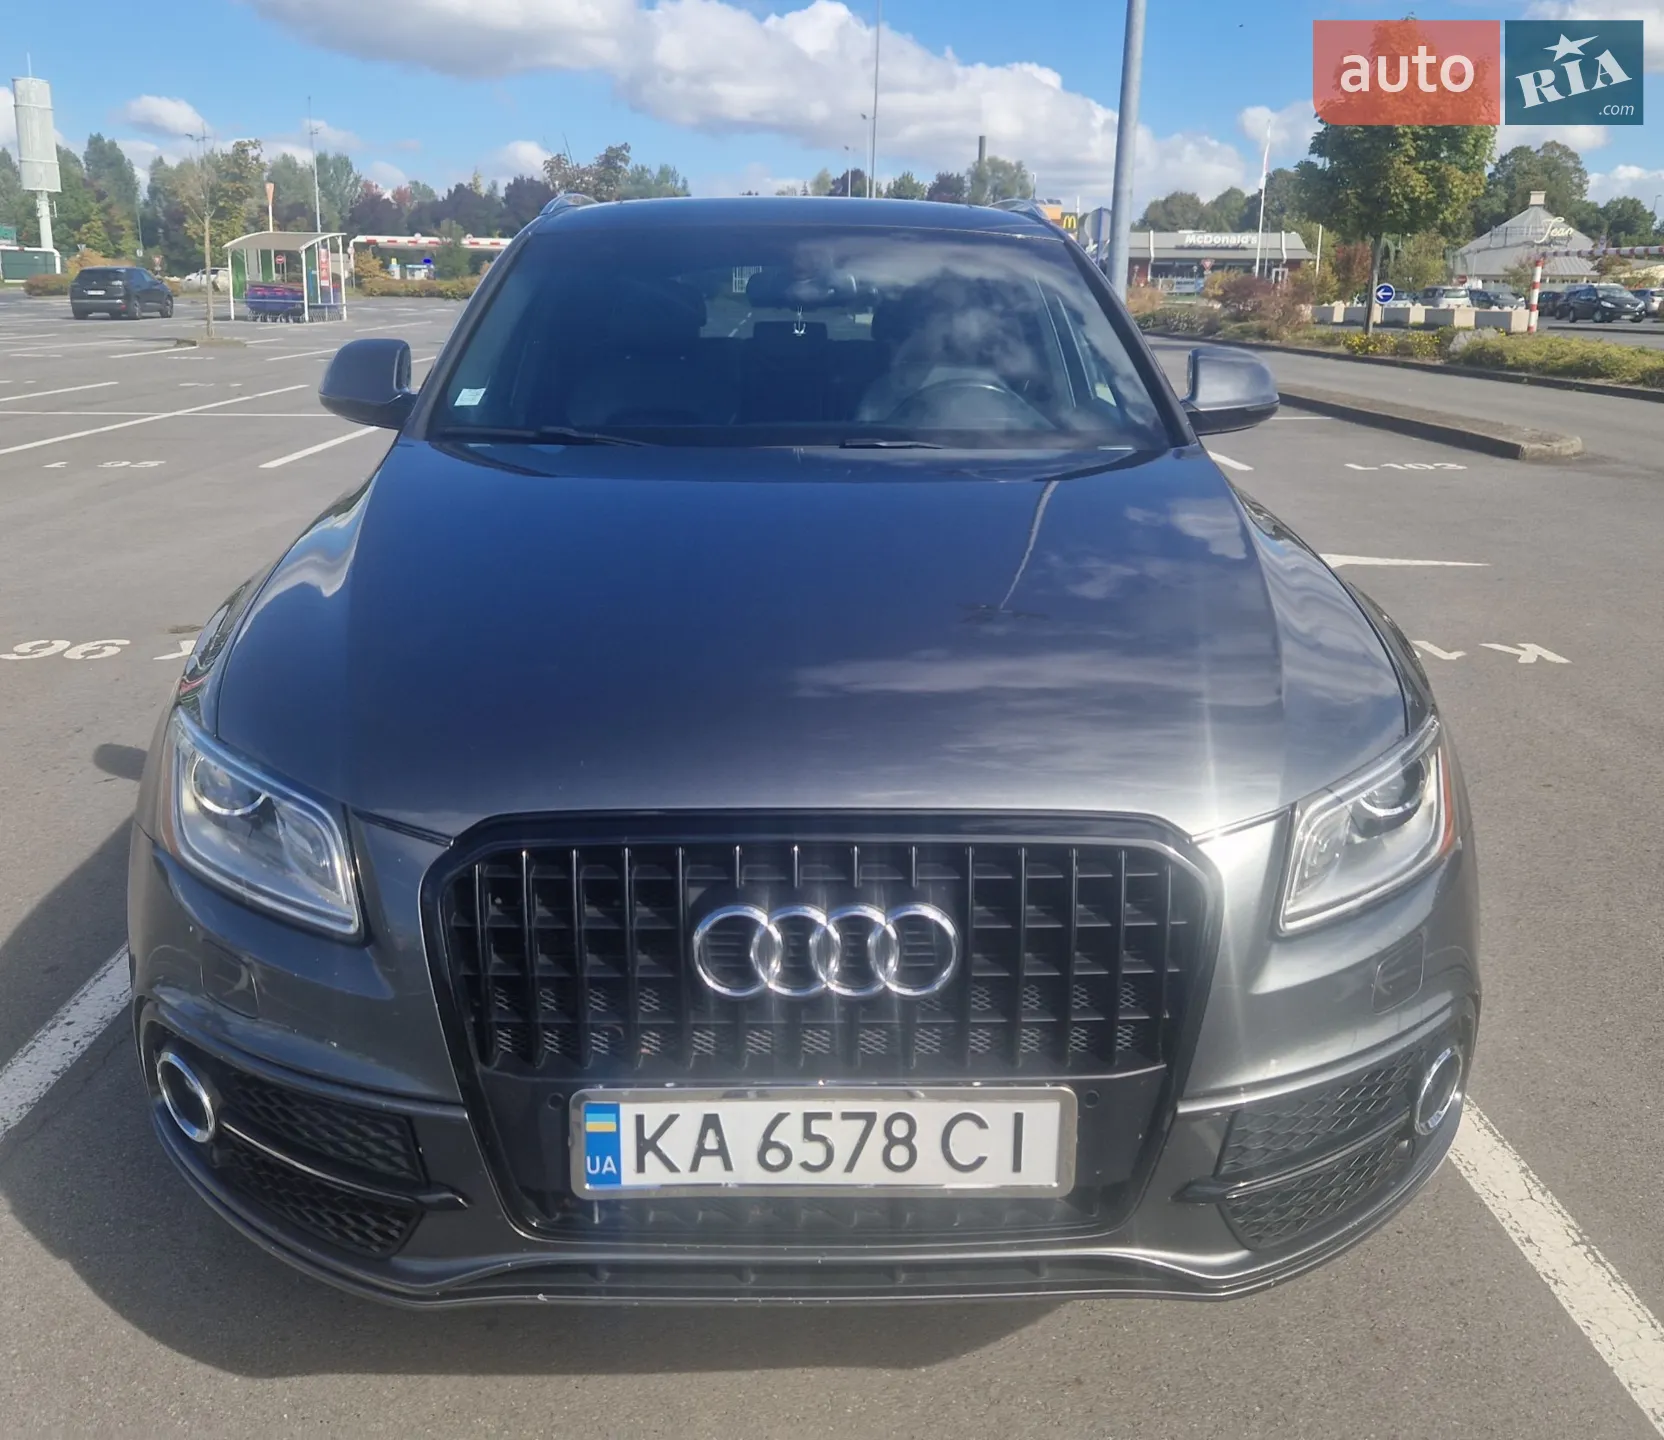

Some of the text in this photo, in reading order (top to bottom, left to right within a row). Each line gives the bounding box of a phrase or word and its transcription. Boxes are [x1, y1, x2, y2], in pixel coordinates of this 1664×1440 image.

[1185, 233, 1259, 245] McDonald's
[0, 639, 131, 660] 96
[634, 1111, 1025, 1174] KA 6578 CI
[586, 1155, 618, 1175] UA
